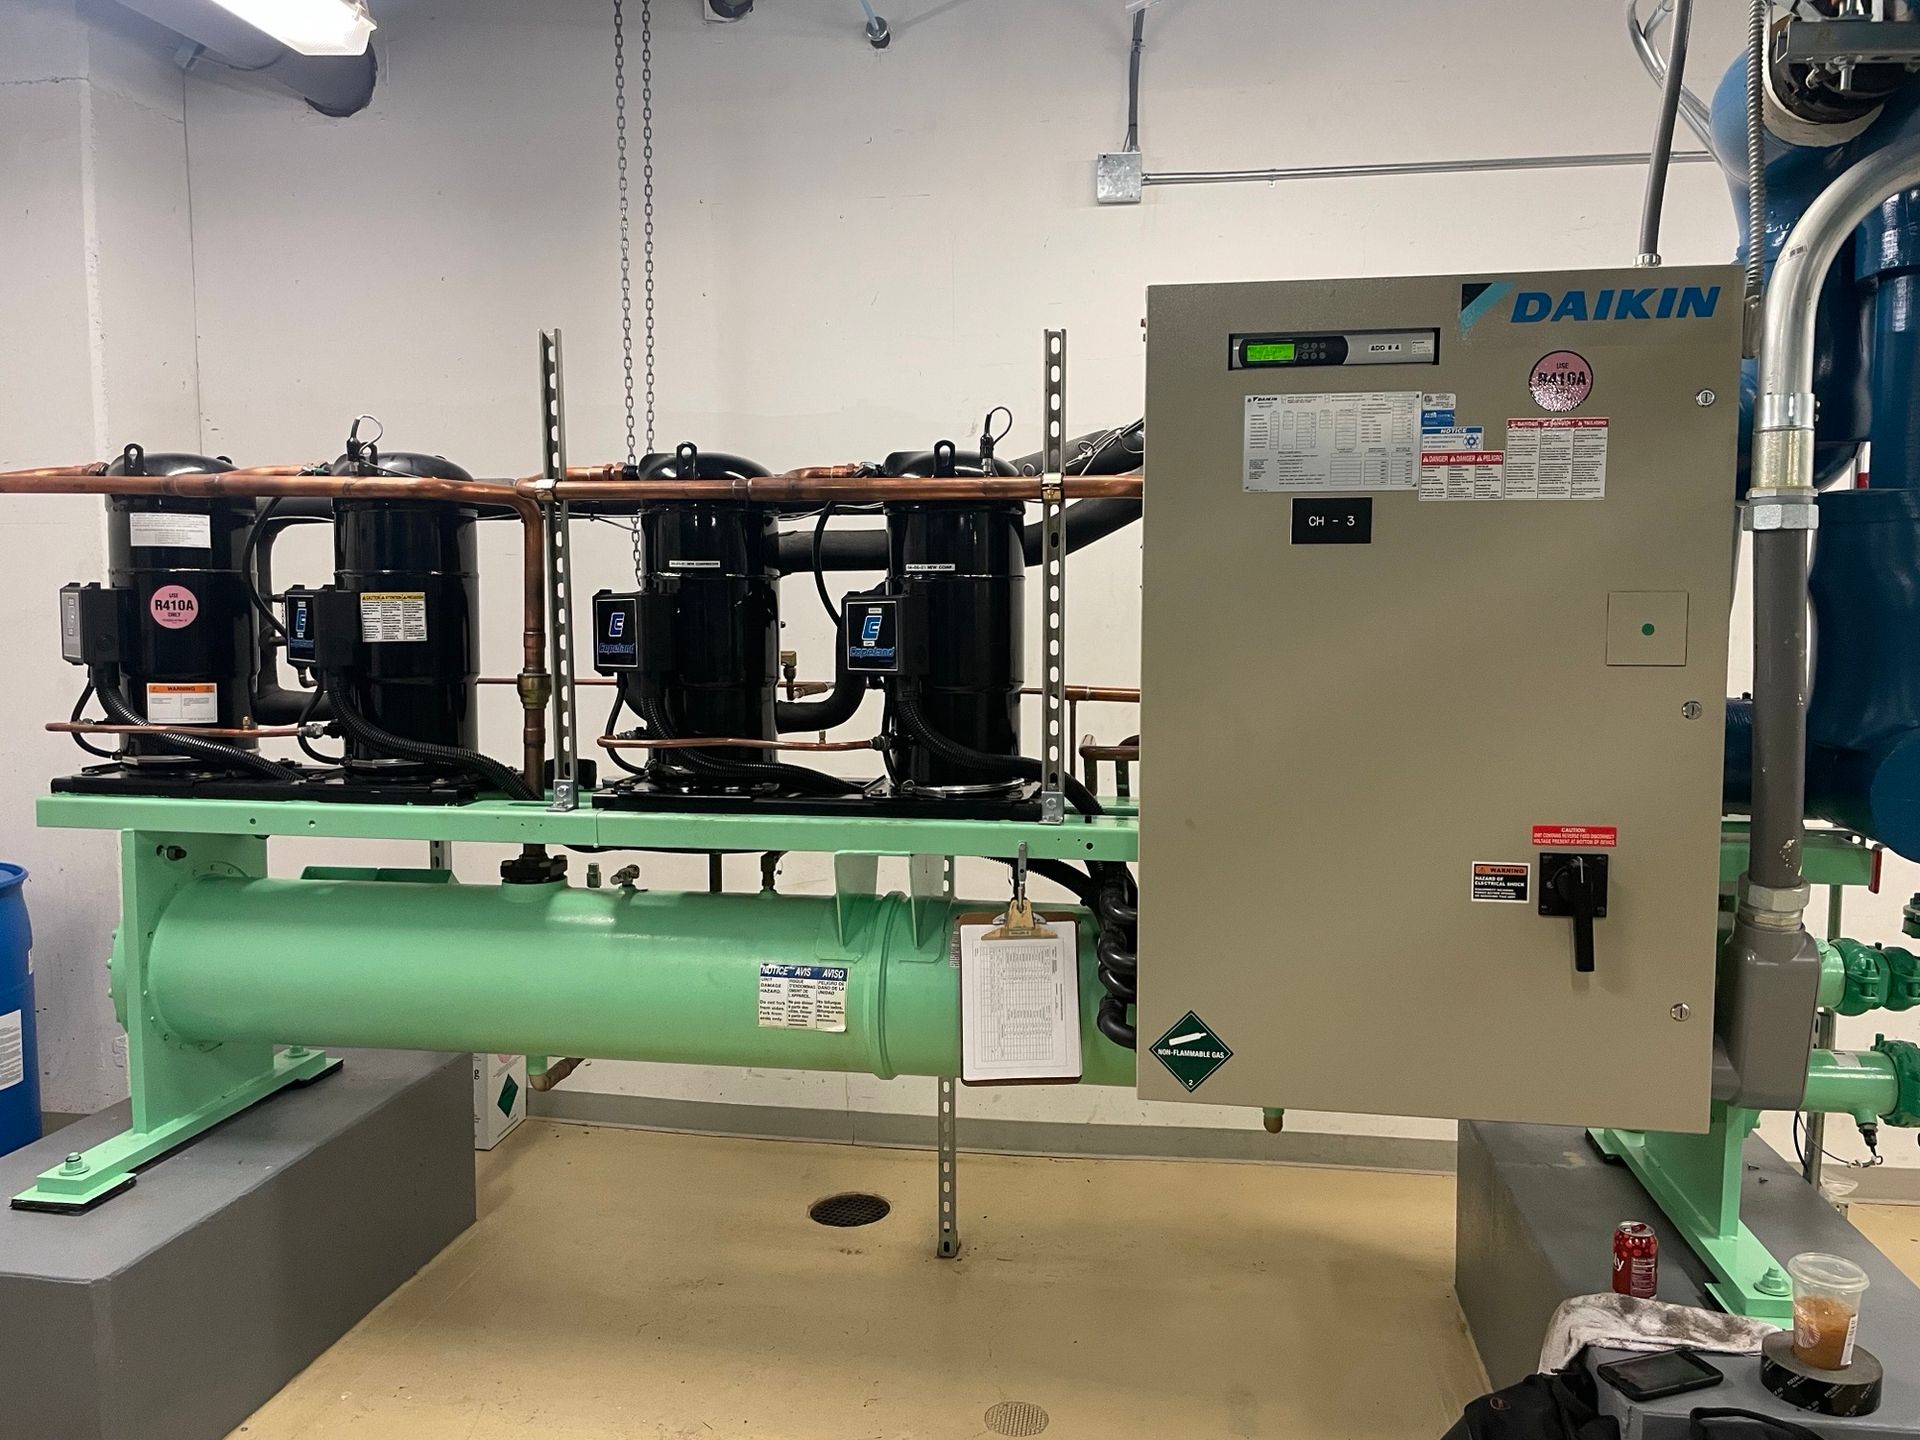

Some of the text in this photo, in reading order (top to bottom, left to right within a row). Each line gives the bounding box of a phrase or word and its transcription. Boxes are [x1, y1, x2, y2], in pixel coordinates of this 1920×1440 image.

[1510, 286, 1721, 323] DAIKIN
[1556, 362, 1569, 370] USE
[1538, 371, 1587, 386] R410A
[1482, 454, 1503, 462] PELIGRO
[1308, 515, 1325, 527] CH
[1346, 515, 1355, 527] 3
[155, 600, 194, 611] R410A
[599, 643, 635, 655] Copeland
[850, 646, 895, 658] Copeland
[761, 964, 789, 976] NOTICE
[794, 967, 812, 977] AVIS
[822, 969, 844, 979] AVISO
[1158, 1048, 1225, 1059] NON-FLAMMABLE GAS
